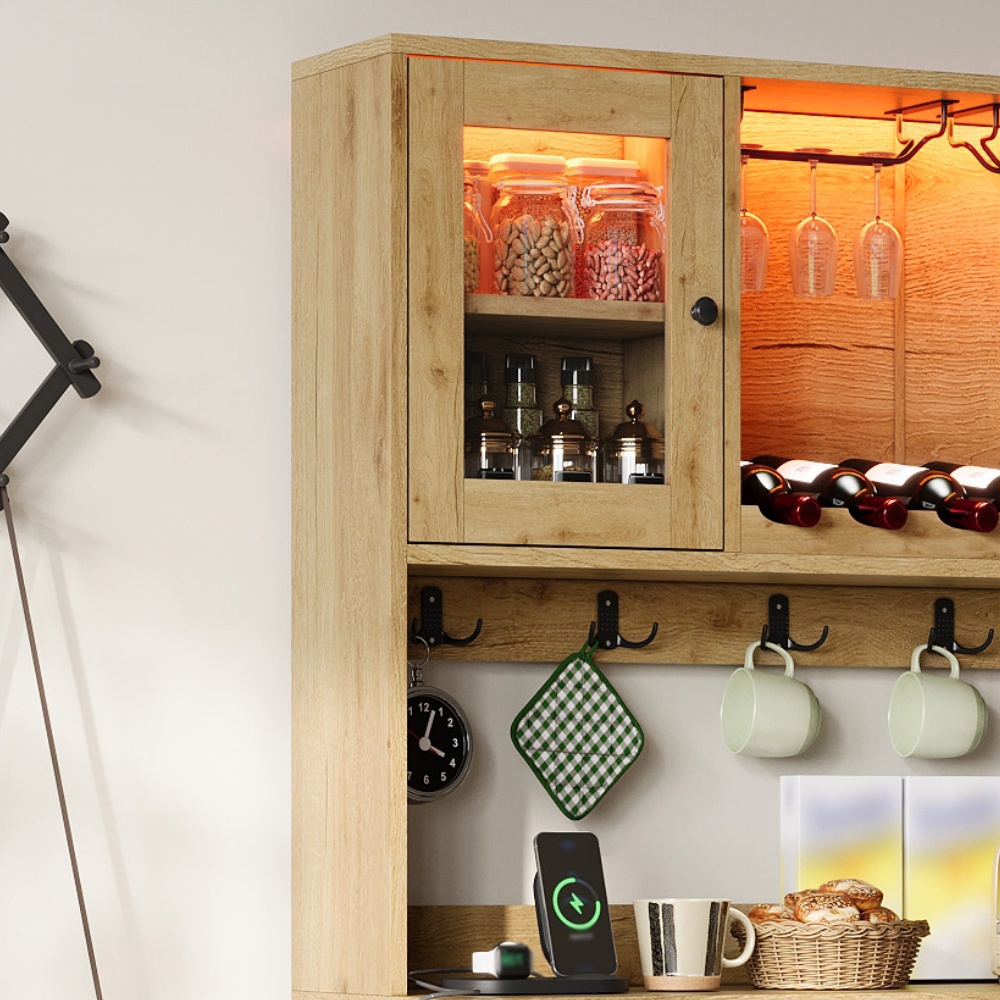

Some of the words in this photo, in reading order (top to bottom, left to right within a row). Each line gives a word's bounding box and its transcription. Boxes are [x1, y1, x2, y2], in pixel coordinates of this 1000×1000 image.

[418, 703, 430, 712] 12
[438, 707, 444, 717] 1
[447, 718, 454, 727] 2
[452, 738, 459, 748] 3
[449, 758, 456, 768] 4
[423, 775, 430, 784] 6
[440, 772, 447, 781] 5
